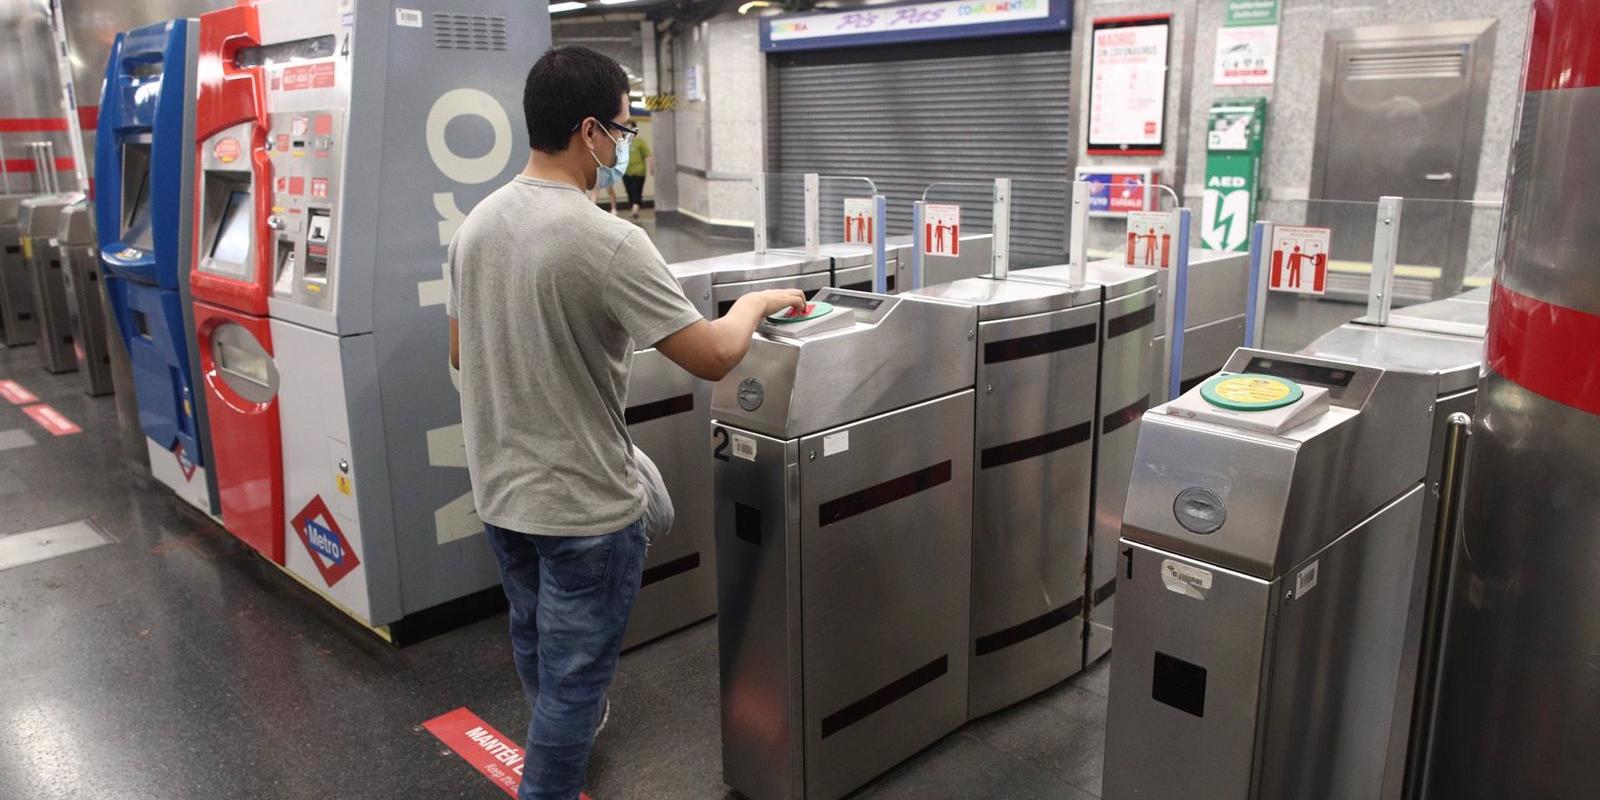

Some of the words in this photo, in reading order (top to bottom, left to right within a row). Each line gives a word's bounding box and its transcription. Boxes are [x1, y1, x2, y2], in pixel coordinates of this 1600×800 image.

[341, 32, 349, 62] 4
[1208, 175, 1246, 188] AED
[713, 426, 730, 462] 2
[308, 524, 340, 559] Metro
[1122, 547, 1134, 580] 1
[465, 726, 524, 766] MANTÉN
